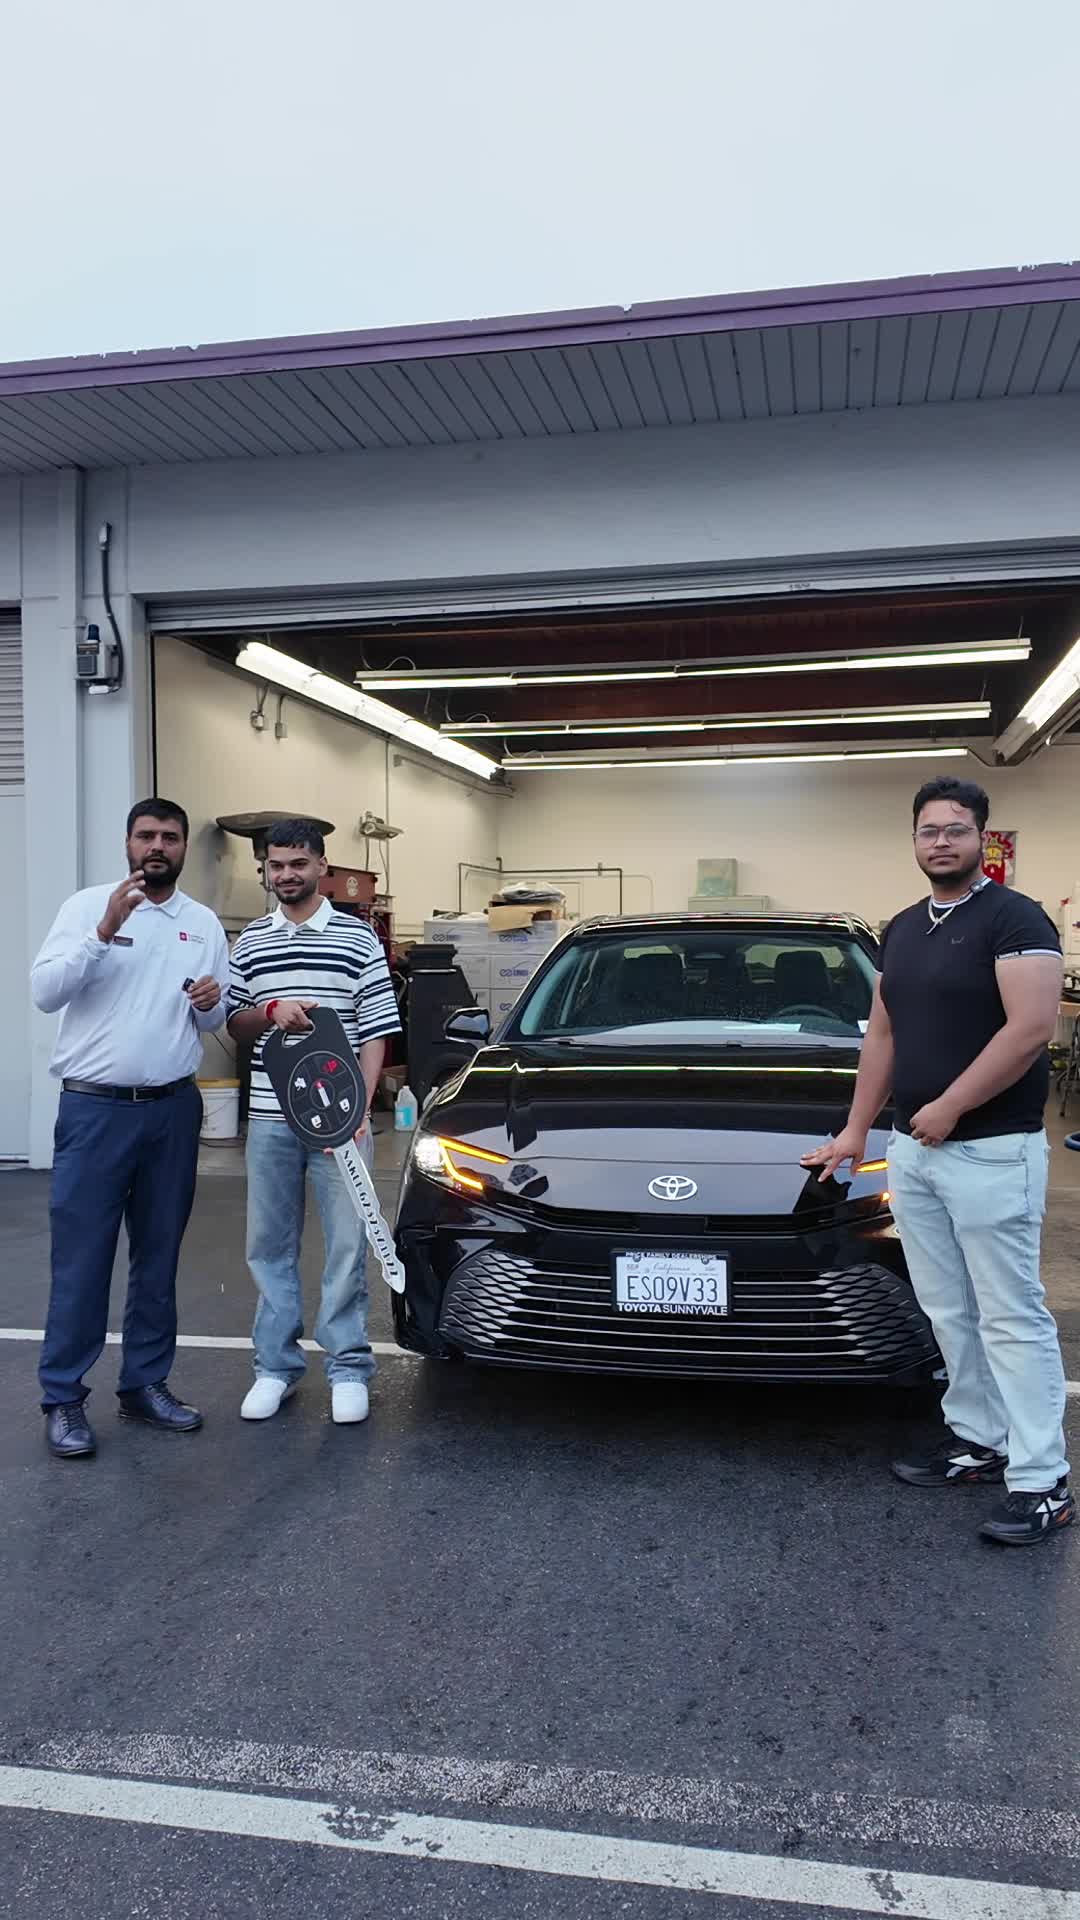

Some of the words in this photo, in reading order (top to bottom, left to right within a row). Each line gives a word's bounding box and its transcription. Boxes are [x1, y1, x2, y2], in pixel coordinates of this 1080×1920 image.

[627, 1275, 719, 1303] ES09V33
[617, 1303, 661, 1313] TOYOTA
[662, 1304, 728, 1316] SUNNYVALE
